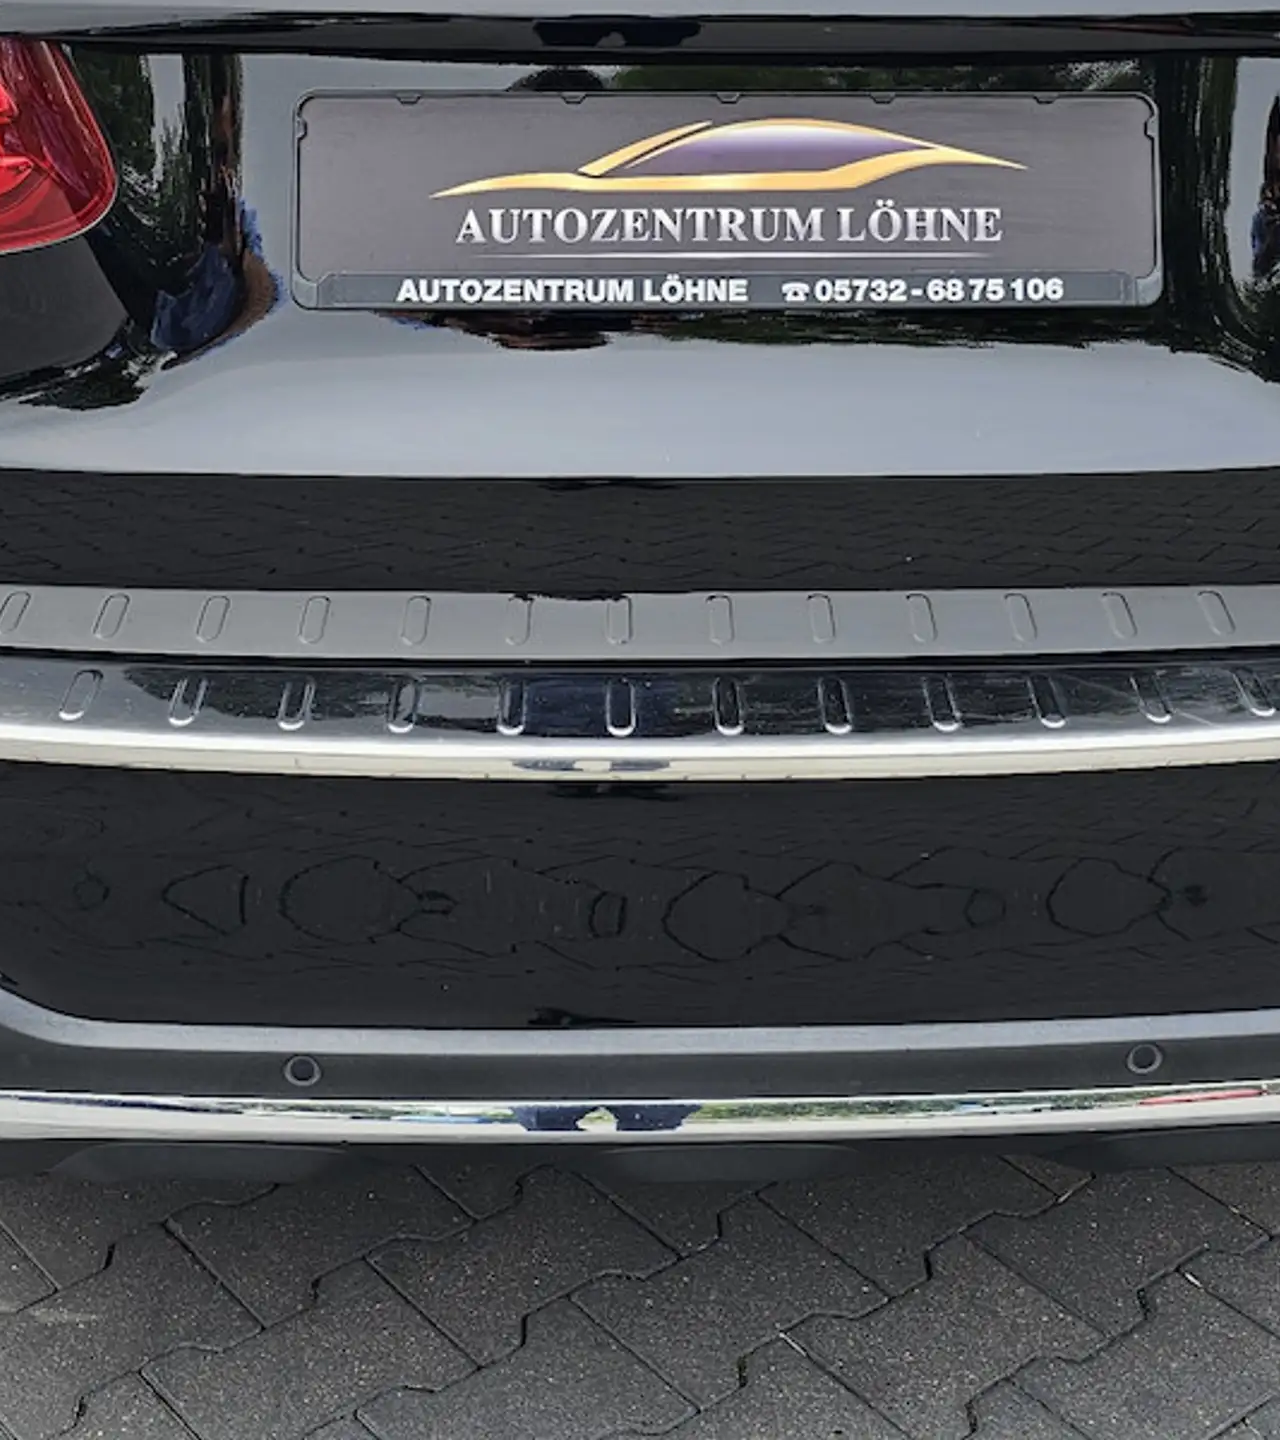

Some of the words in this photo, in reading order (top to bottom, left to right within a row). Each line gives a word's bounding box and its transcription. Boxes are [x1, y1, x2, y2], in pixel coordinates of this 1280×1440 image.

[455, 207, 825, 244] AUTOZENTRUM
[836, 198, 1003, 243] LÖHNE
[396, 278, 634, 303] AUTOZENTRUM
[642, 273, 749, 303] LÖHNE
